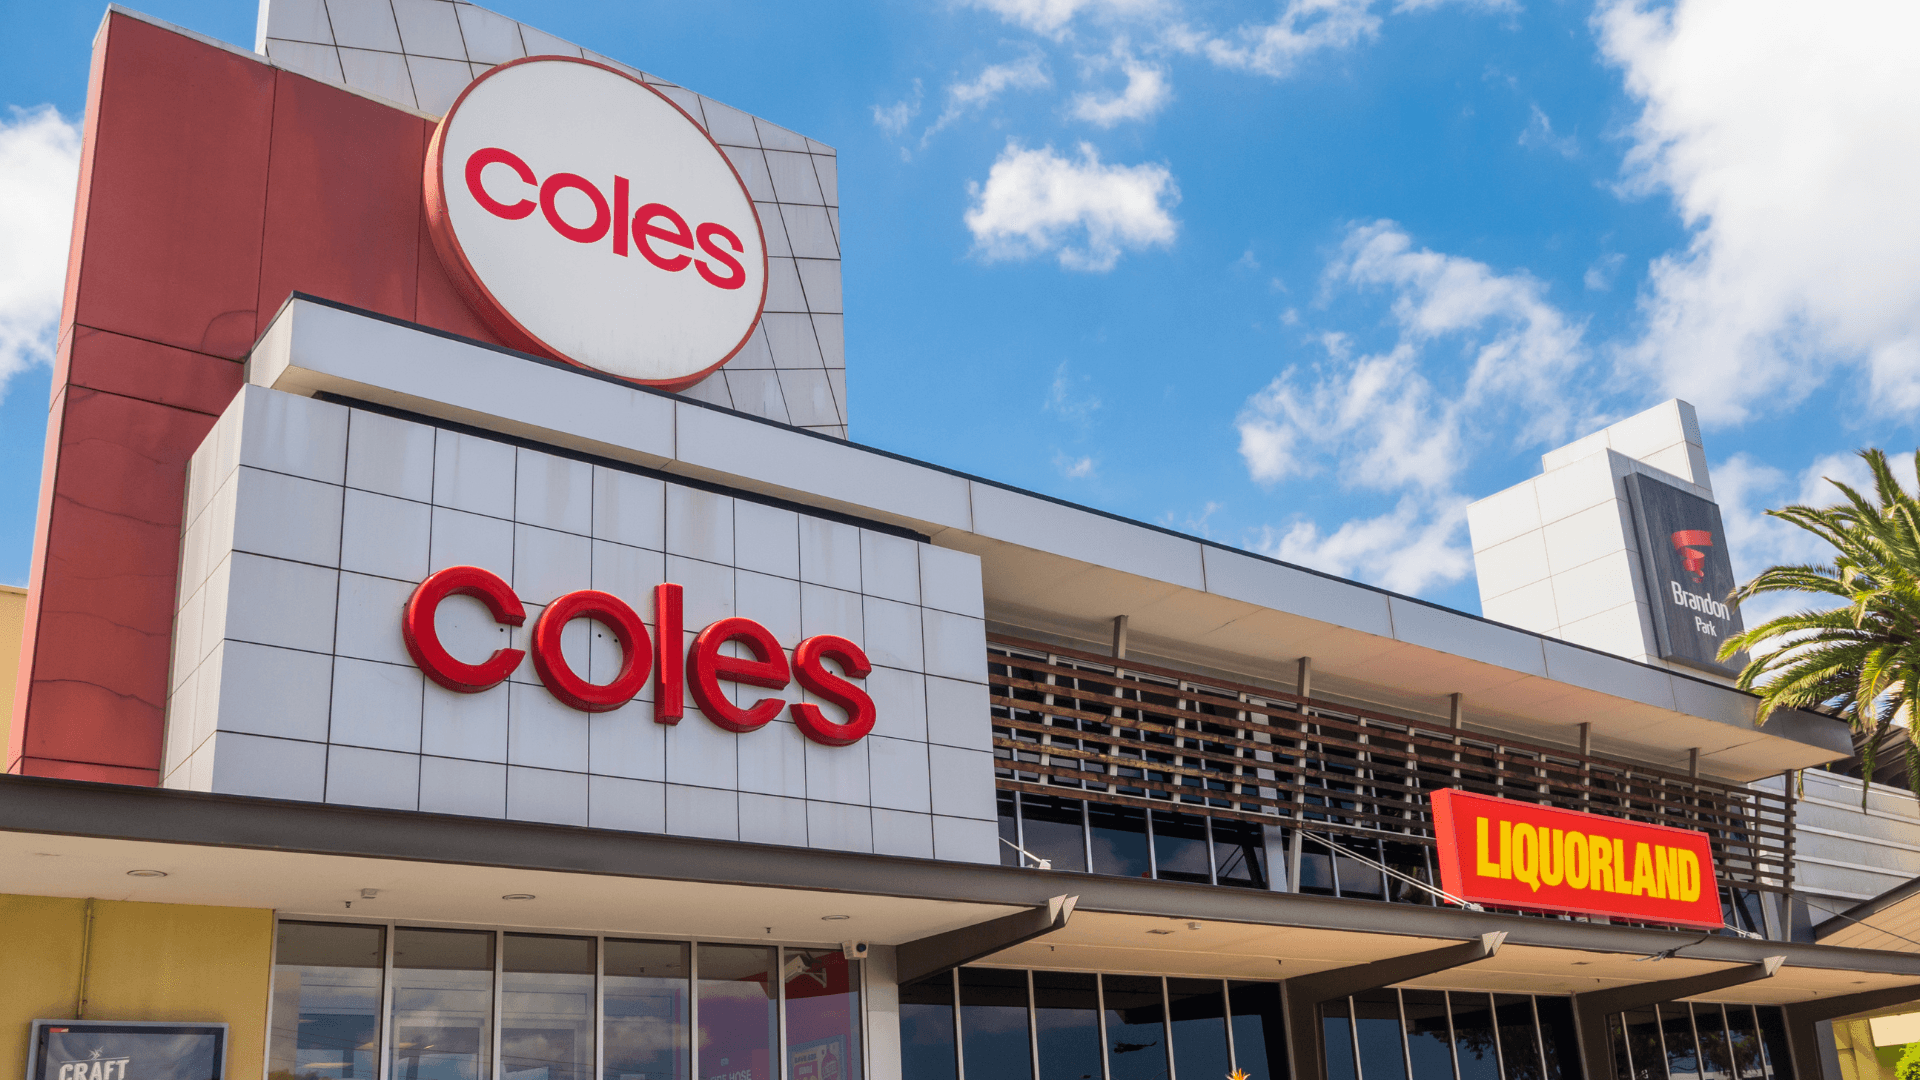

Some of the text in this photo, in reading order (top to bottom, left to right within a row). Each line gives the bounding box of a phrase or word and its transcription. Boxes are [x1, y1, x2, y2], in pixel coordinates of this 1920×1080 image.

[465, 147, 746, 290] coles
[1671, 581, 1730, 621] Brandon
[1695, 616, 1717, 637] Park
[402, 565, 876, 747] coles
[1476, 816, 1700, 903] LIQUORLAND
[58, 1060, 131, 1080] CRAFT
